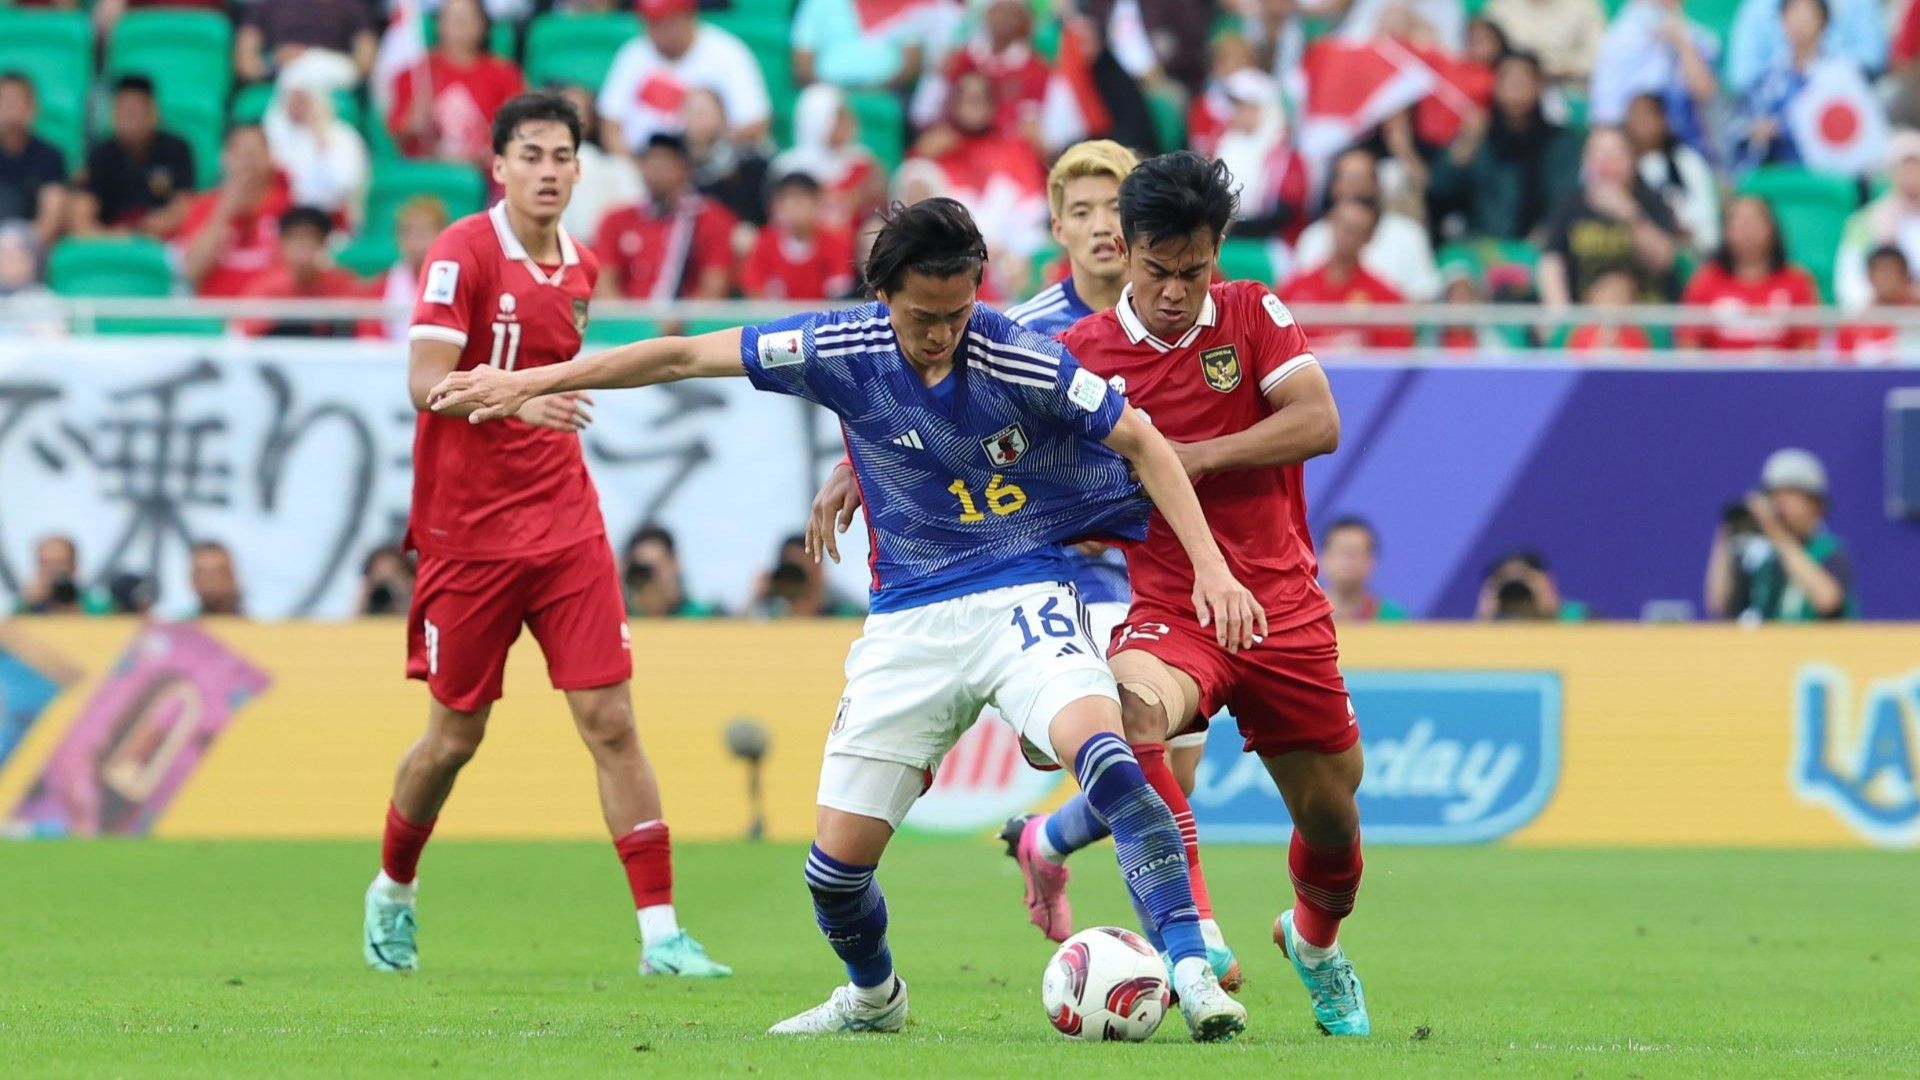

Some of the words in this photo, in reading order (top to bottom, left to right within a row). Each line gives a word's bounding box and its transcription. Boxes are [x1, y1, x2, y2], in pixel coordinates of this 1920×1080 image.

[490, 322, 522, 371] 11
[947, 473, 1027, 523] 16
[1011, 596, 1076, 652] 16
[1799, 672, 1920, 835] LA
